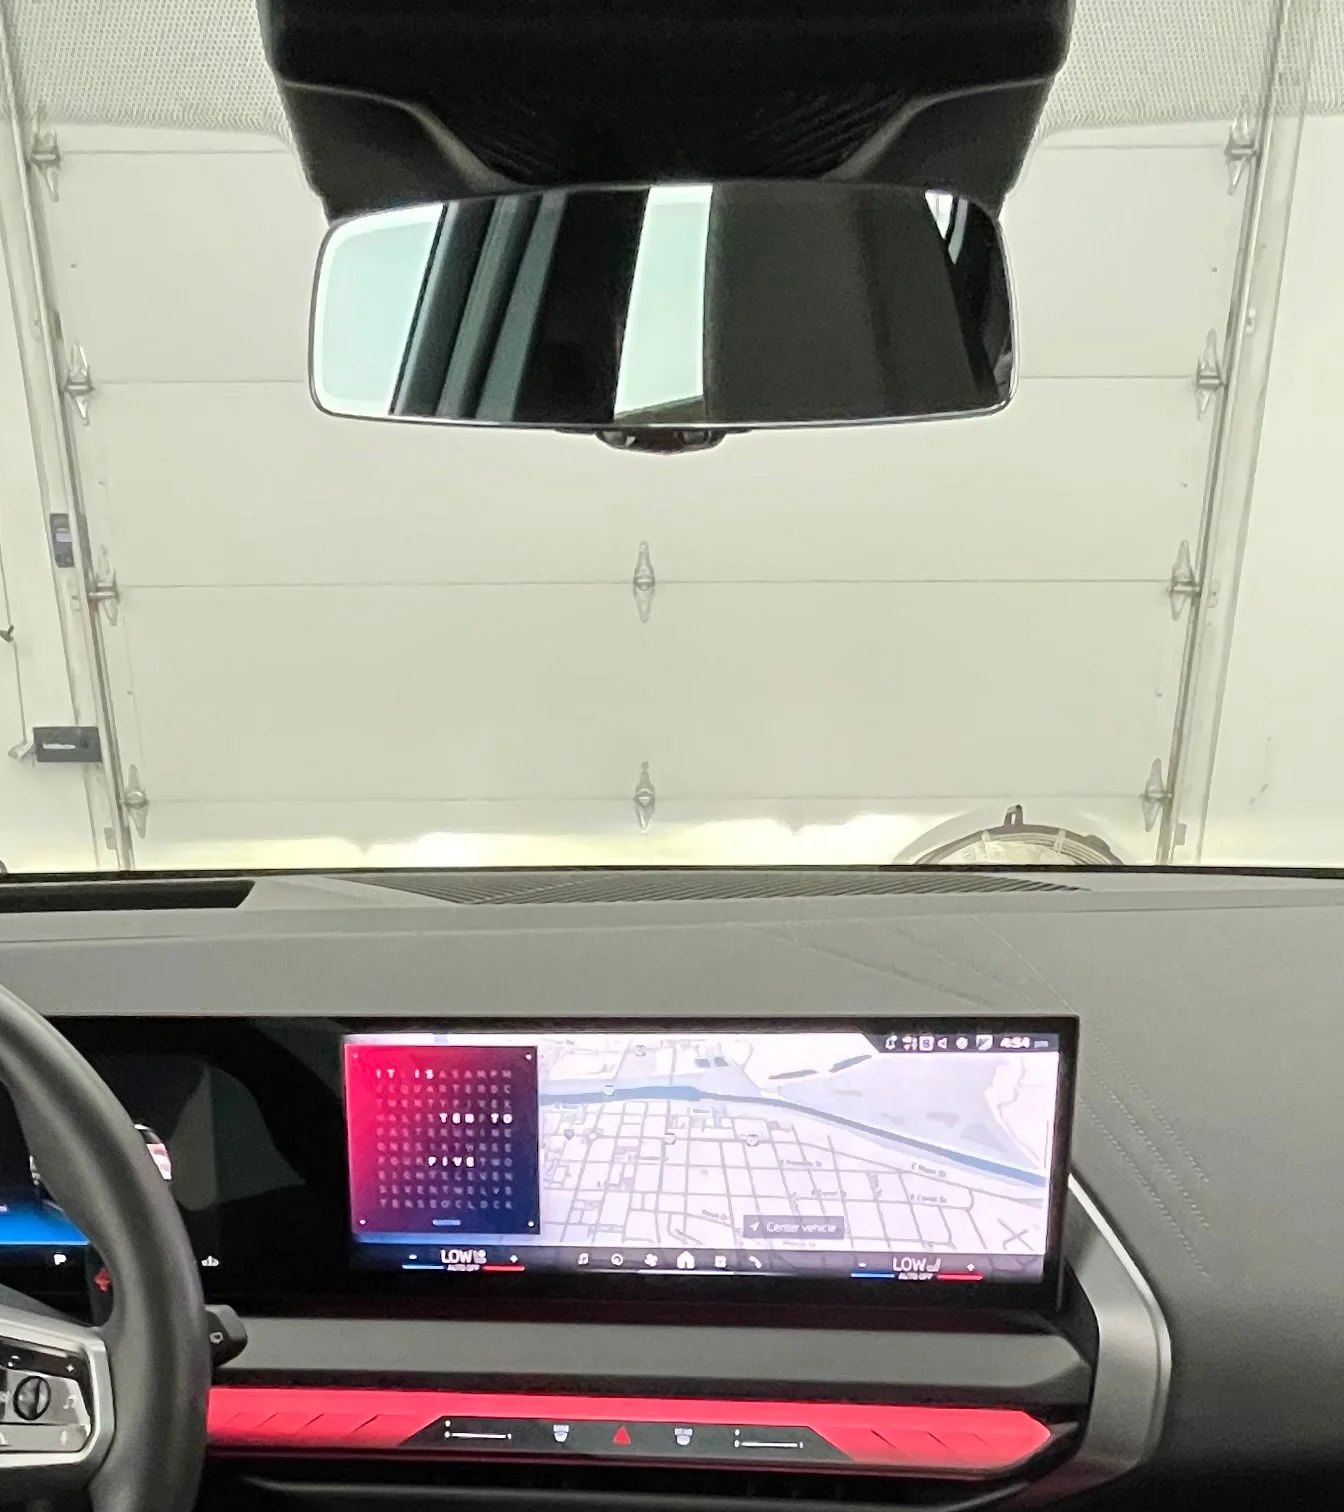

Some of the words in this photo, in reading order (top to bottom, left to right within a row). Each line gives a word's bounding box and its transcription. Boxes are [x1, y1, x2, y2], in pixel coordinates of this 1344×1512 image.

[766, 1221, 800, 1234] Center
[802, 1221, 838, 1234] vehicle
[440, 1249, 473, 1264] LOW
[892, 1256, 927, 1273] LOW
